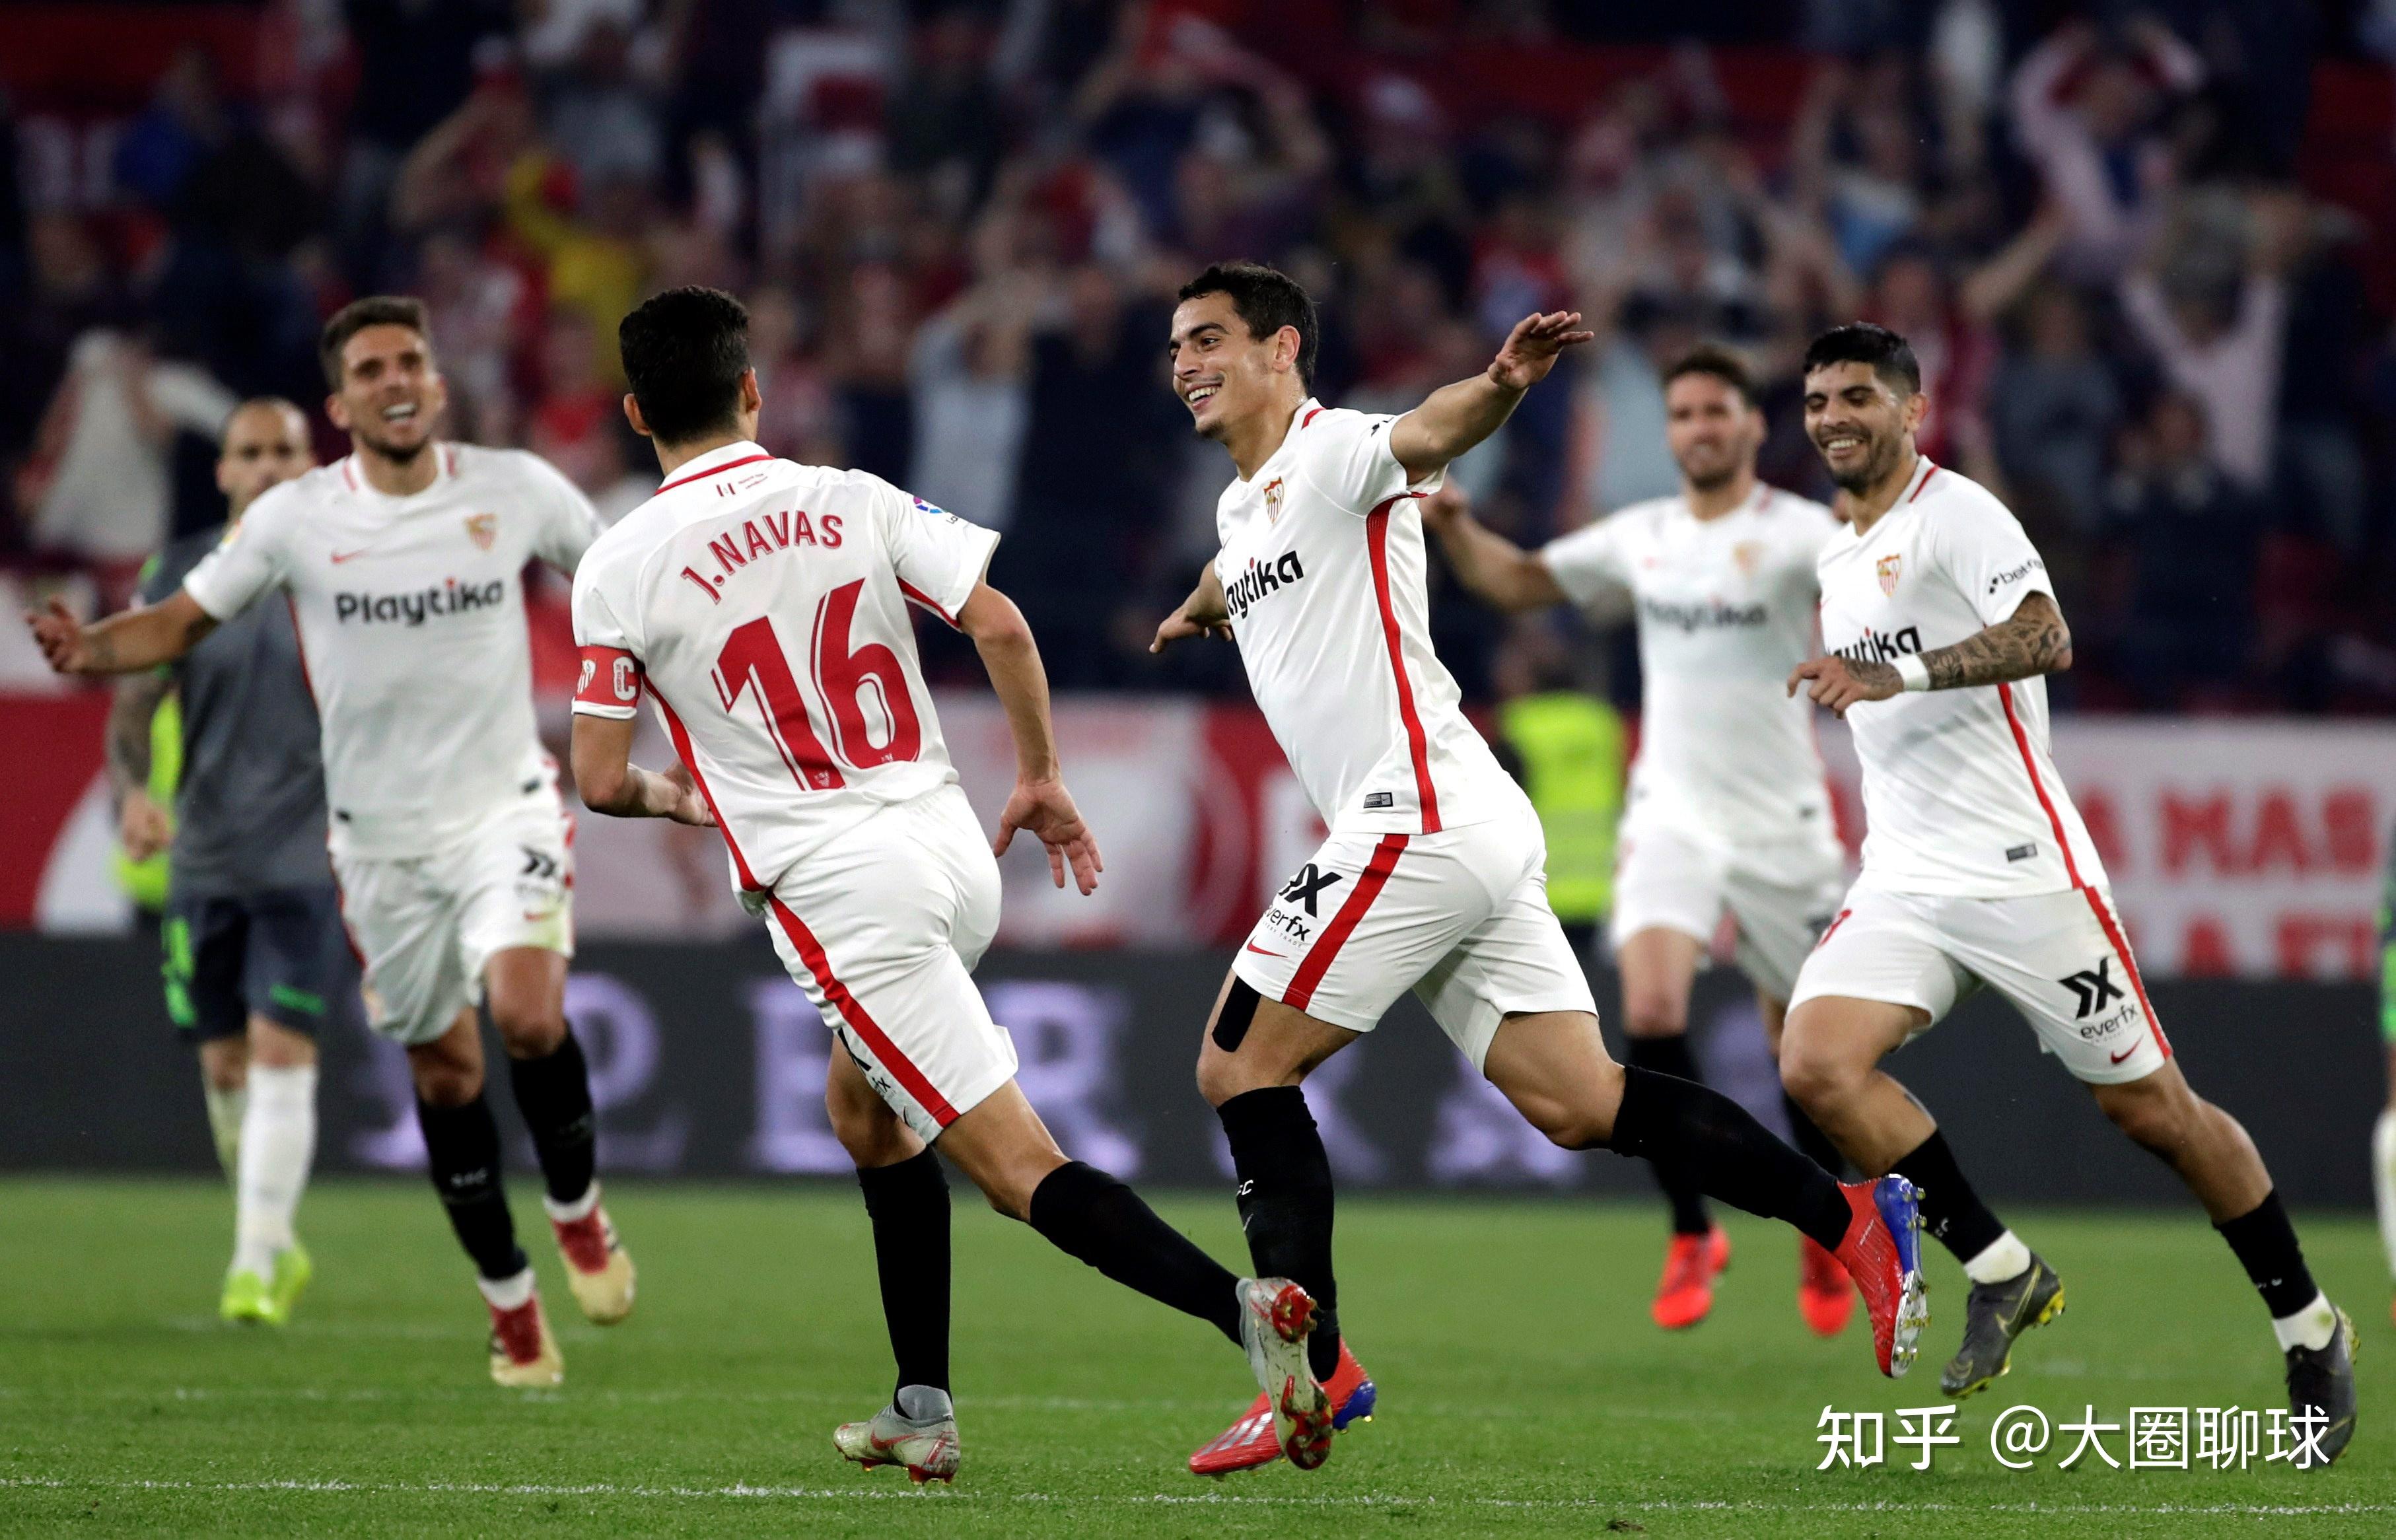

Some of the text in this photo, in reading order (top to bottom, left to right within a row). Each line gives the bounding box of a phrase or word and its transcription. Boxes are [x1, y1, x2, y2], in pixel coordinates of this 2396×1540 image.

[680, 510, 843, 606] J.NAVAS
[334, 577, 503, 627] Playtika
[613, 656, 636, 701] C
[711, 577, 921, 791] 16
[2081, 1003, 2138, 1039] everfx
